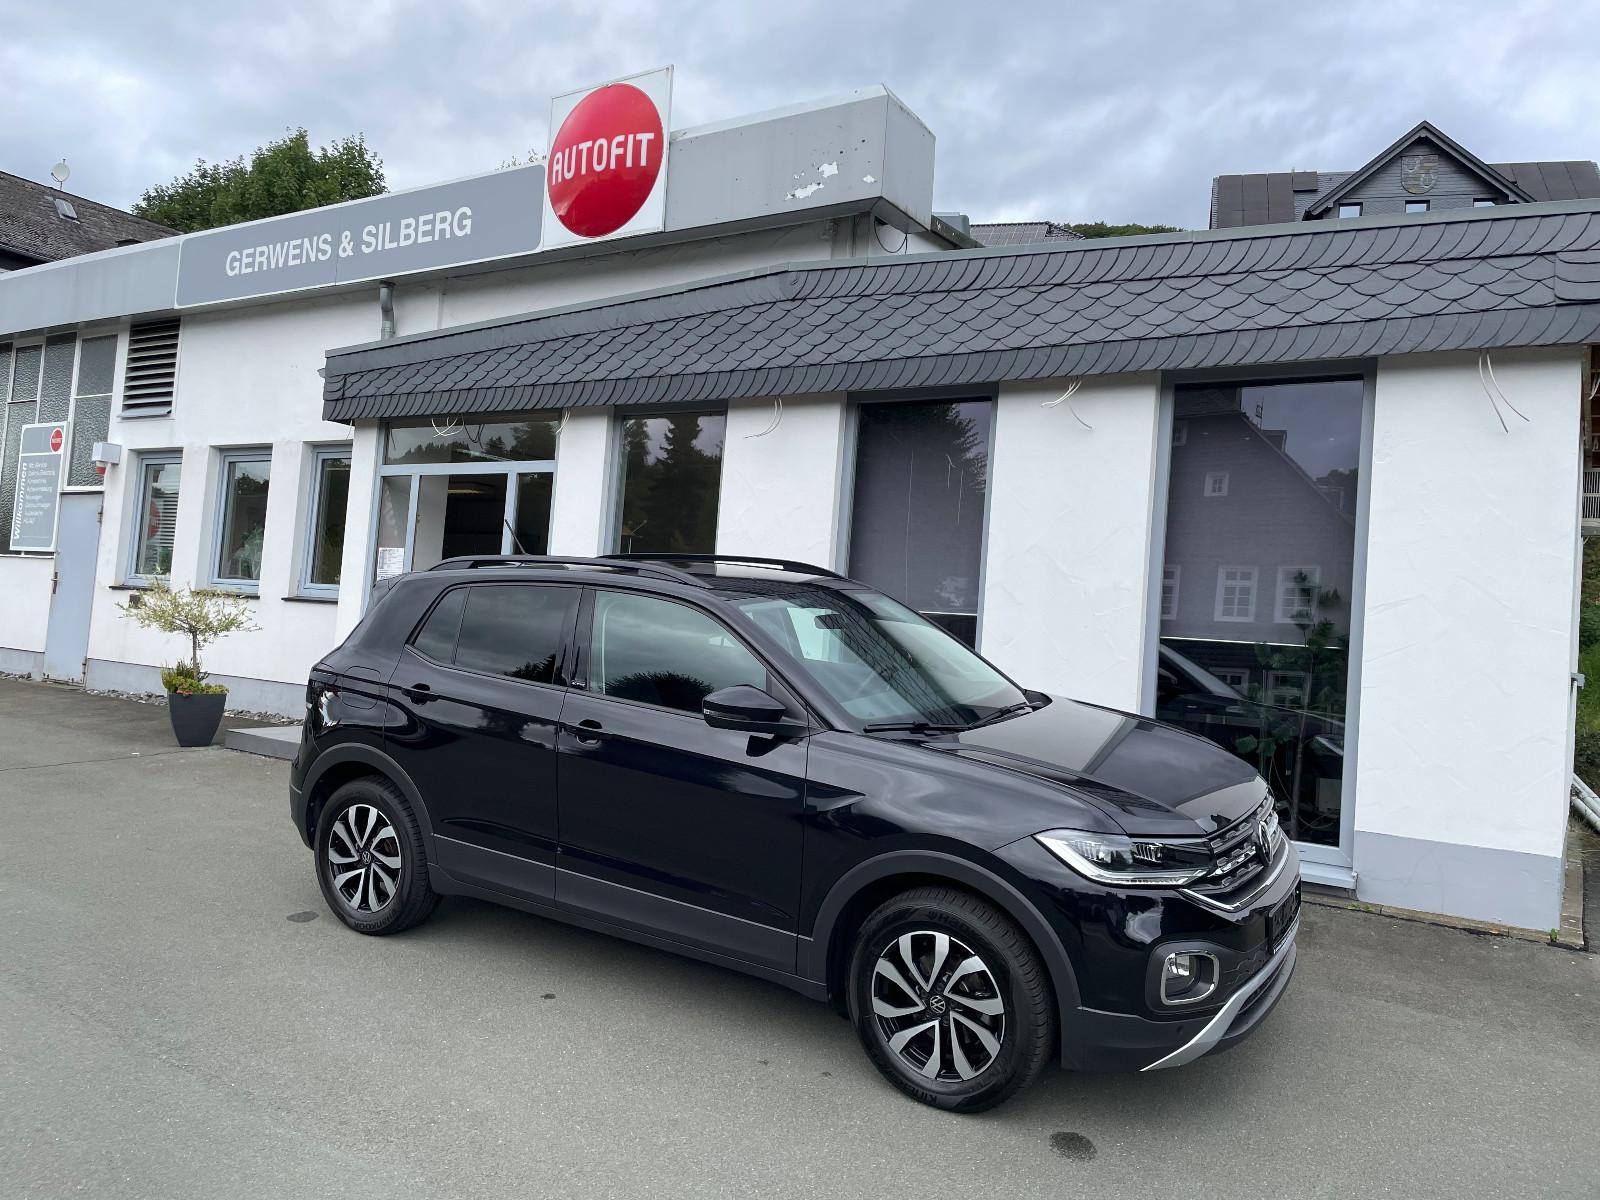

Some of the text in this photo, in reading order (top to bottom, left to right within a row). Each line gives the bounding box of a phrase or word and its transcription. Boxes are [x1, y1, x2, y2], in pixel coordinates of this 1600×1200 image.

[552, 132, 655, 186] AUTOFIT
[225, 206, 472, 277] GERWENS & SILBERG
